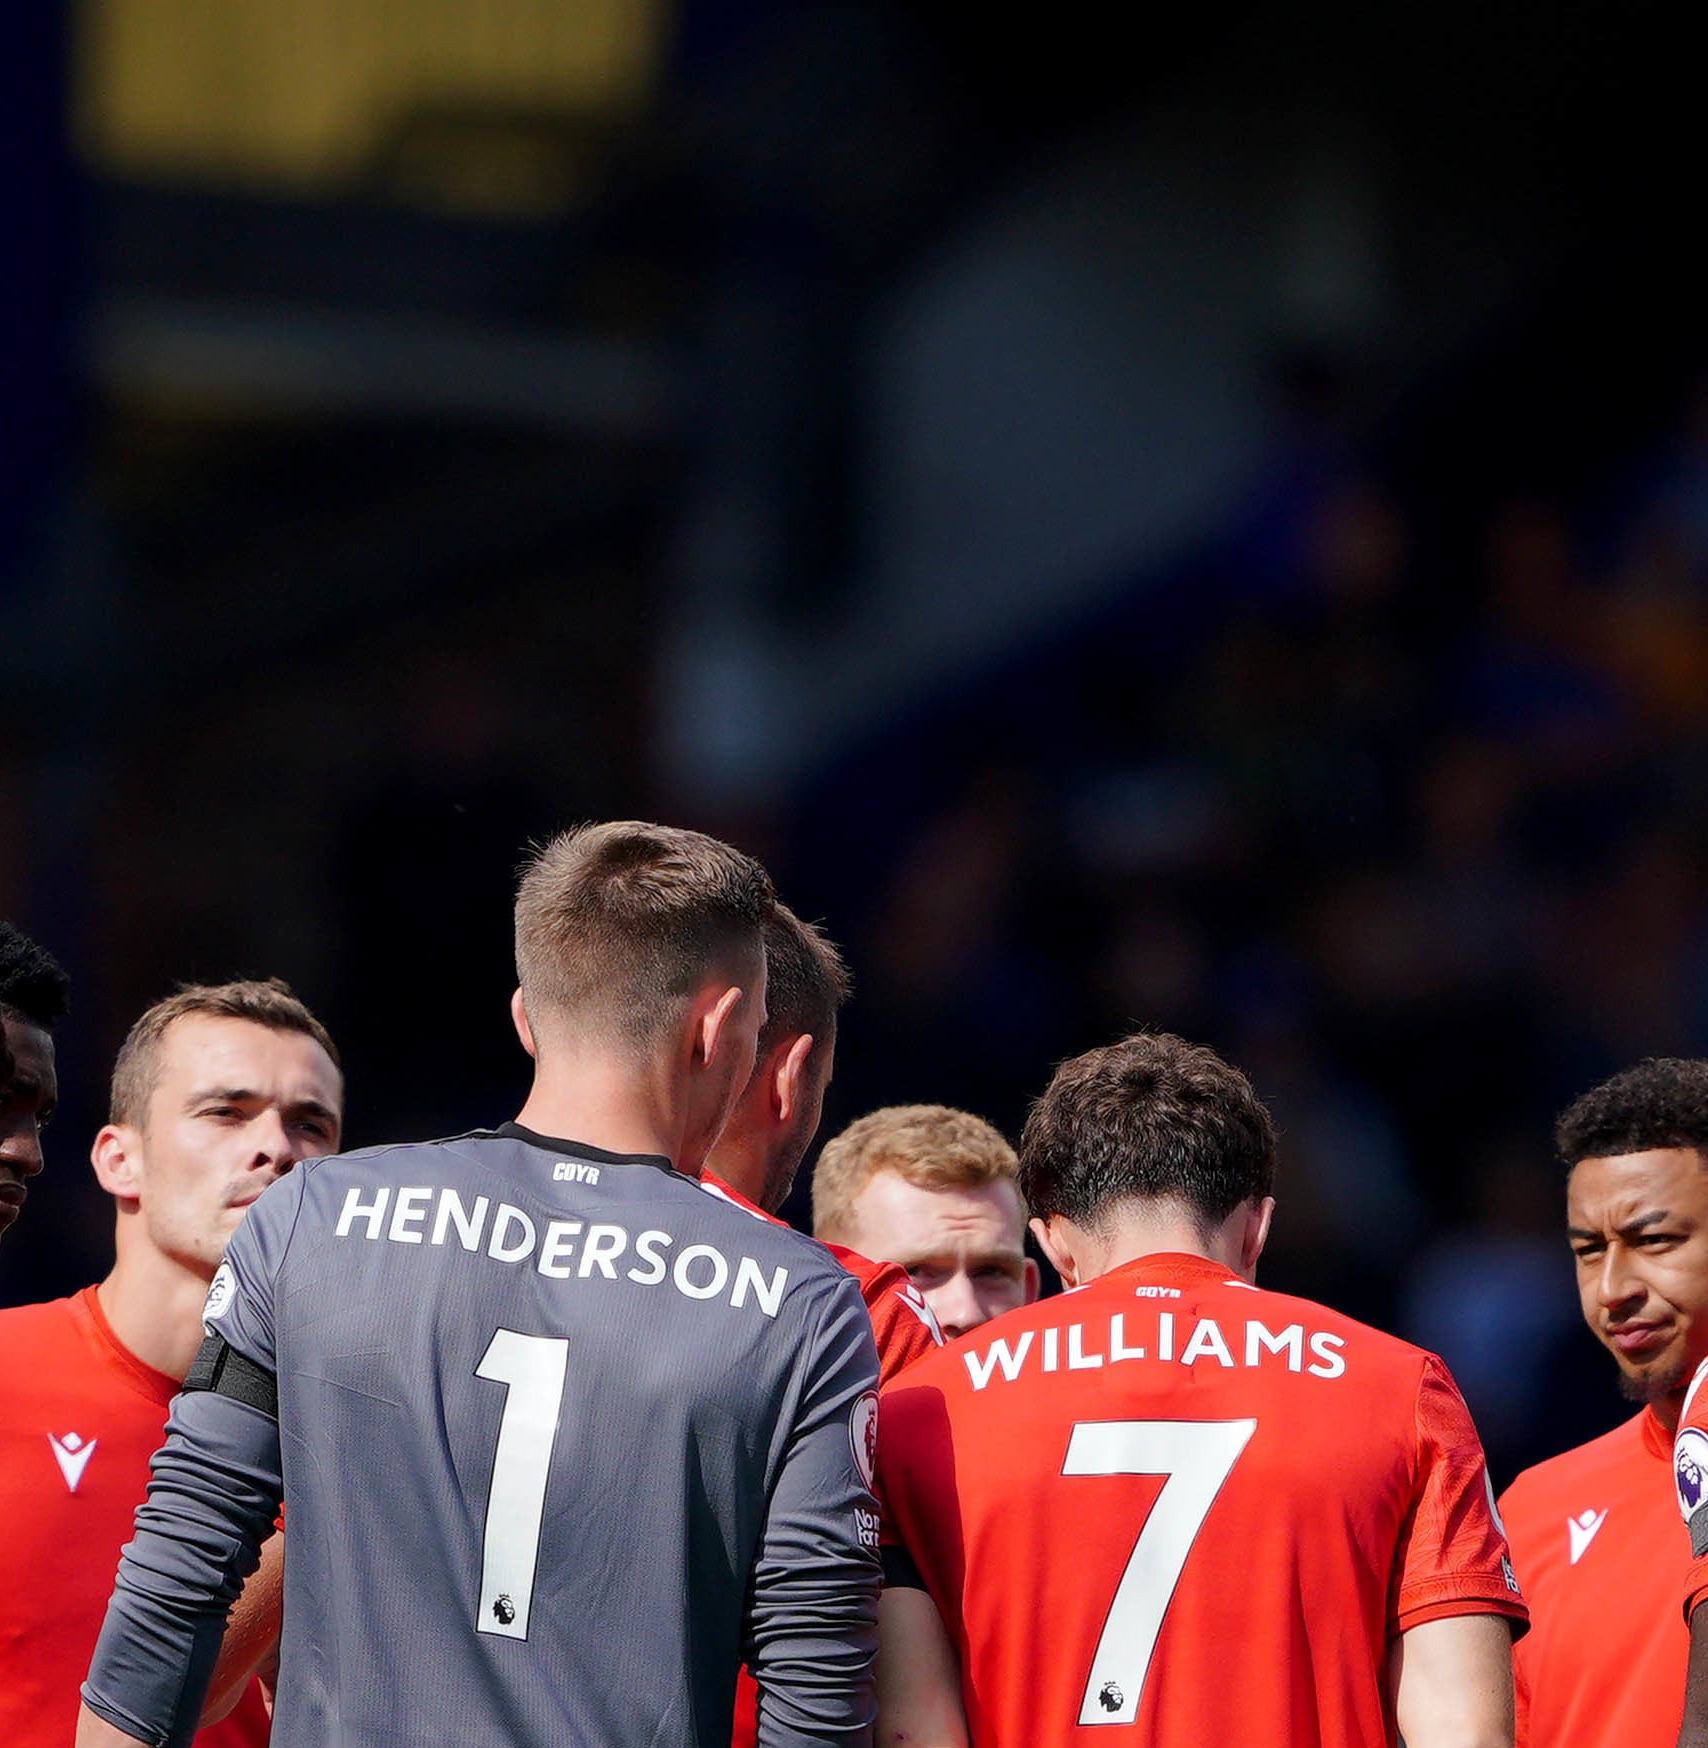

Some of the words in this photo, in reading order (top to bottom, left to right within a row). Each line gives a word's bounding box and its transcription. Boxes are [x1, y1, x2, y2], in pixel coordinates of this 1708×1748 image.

[334, 1186, 790, 1319] HENDERSON
[963, 1312, 1347, 1392] WILLIAMS
[473, 1327, 570, 1641] 1
[1060, 1418, 1257, 1726] 7
